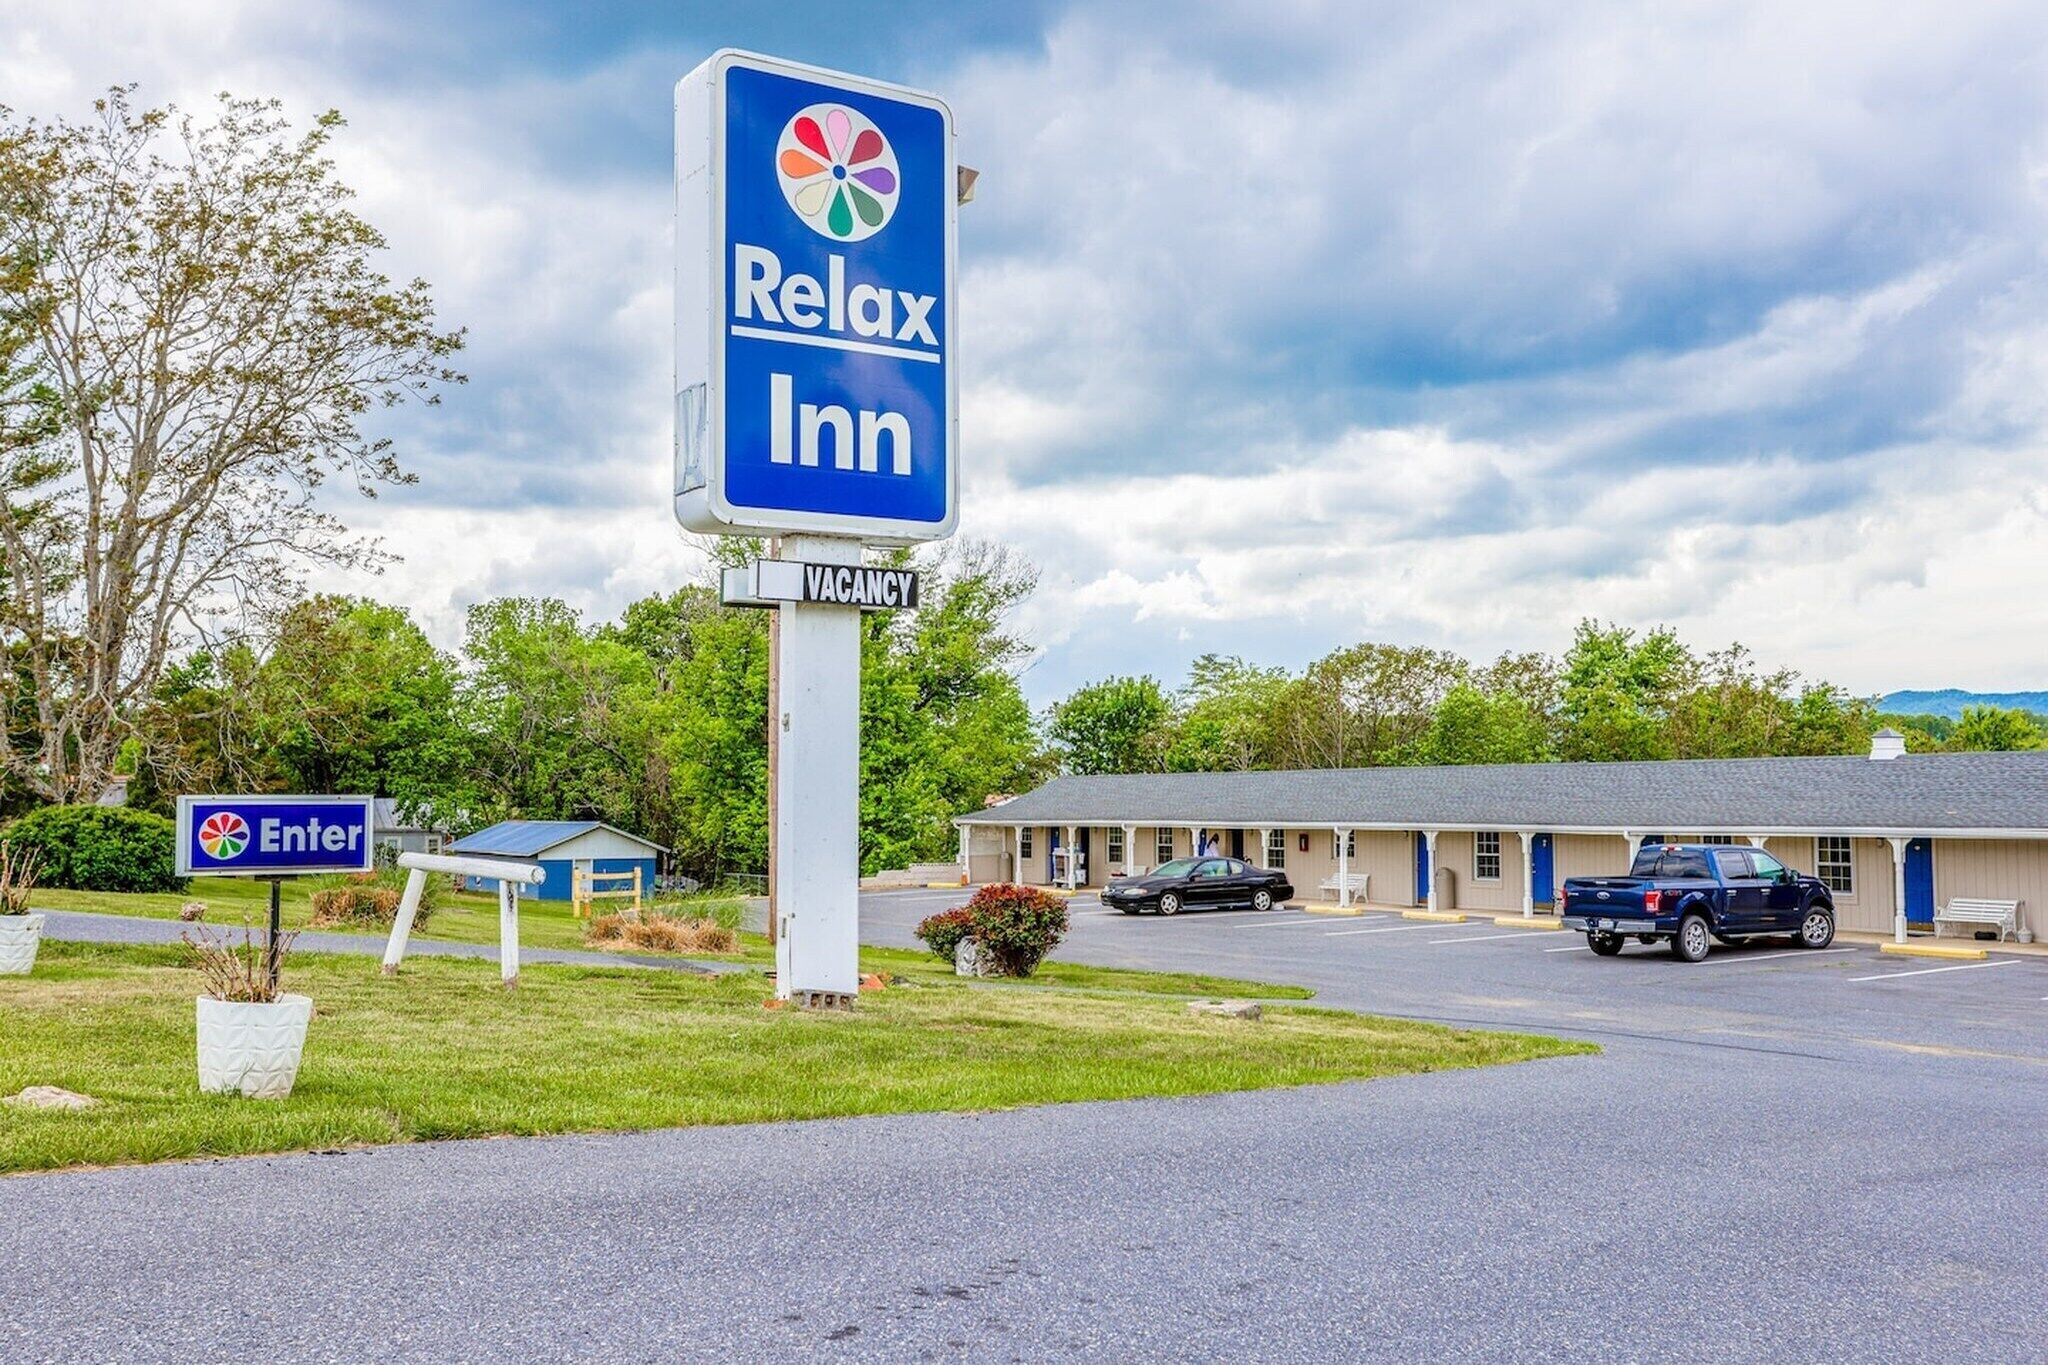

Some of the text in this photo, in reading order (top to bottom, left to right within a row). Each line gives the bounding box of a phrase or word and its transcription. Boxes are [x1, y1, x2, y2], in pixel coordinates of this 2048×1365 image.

[734, 243, 939, 345] Relax
[770, 373, 912, 475] Inn
[806, 566, 912, 606] VACANCY
[260, 817, 363, 852] Enter
